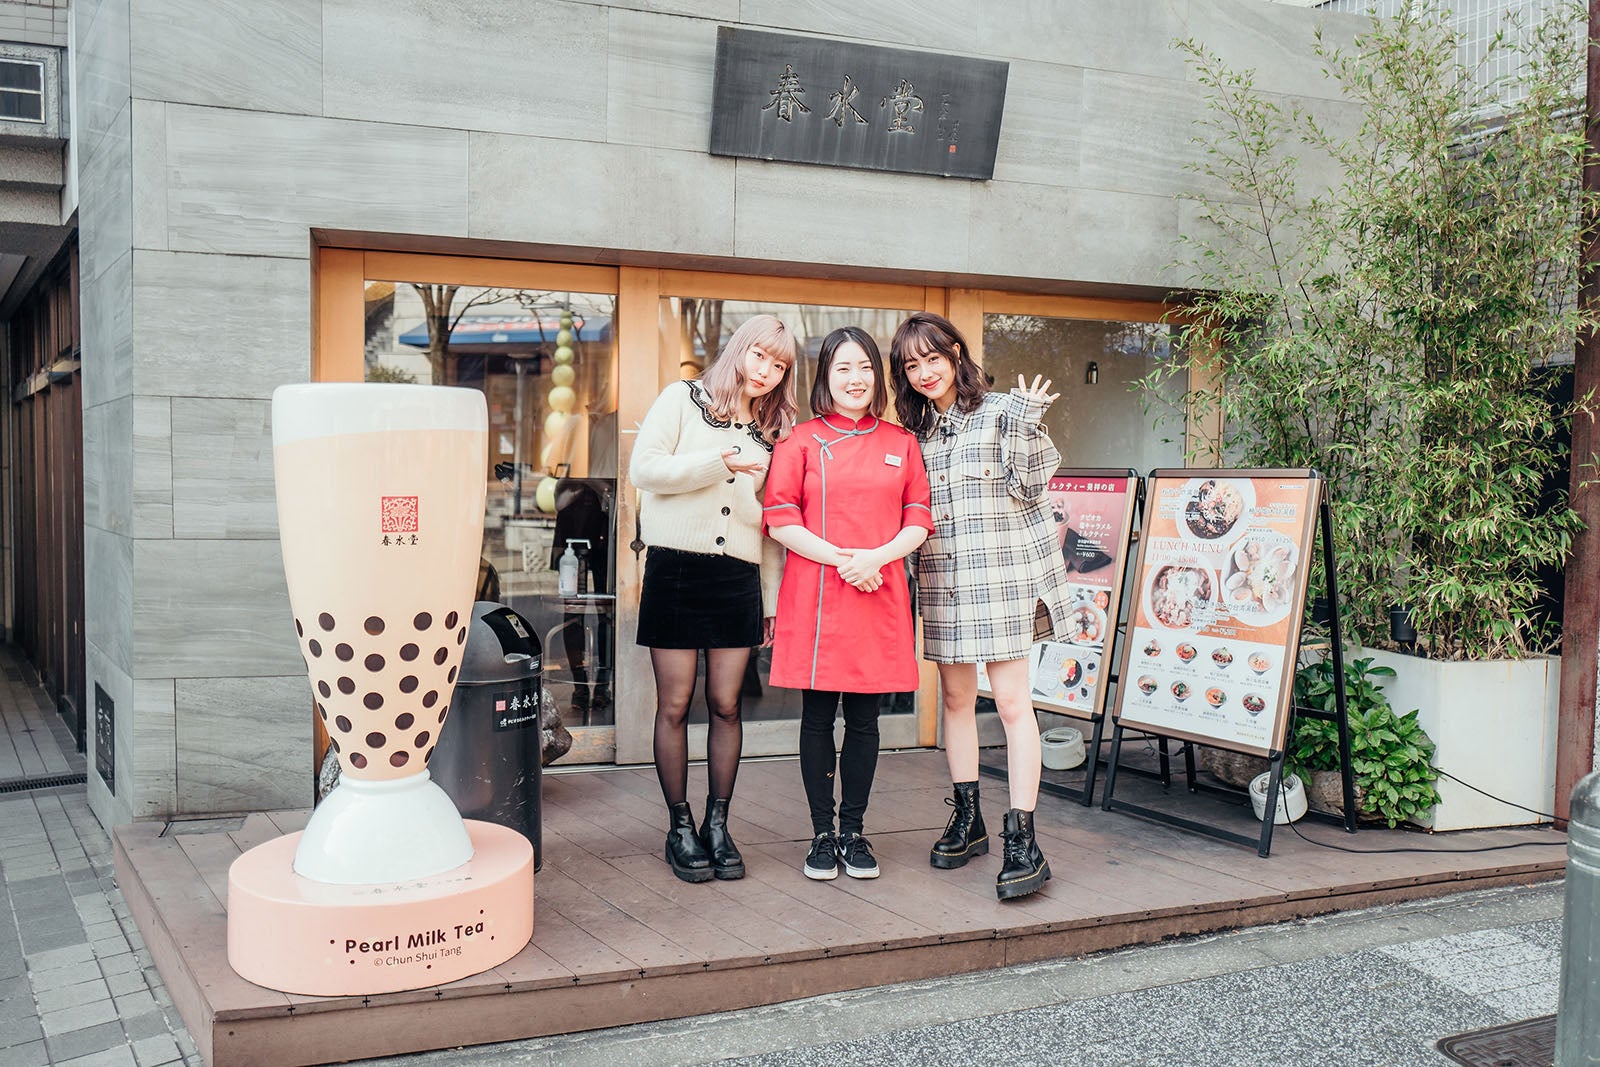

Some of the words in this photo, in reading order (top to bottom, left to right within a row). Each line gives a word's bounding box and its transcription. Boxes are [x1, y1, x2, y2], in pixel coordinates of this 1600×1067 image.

[761, 63, 926, 135] 春水堂
[1047, 482, 1115, 492] ルクティー発祥の店
[381, 533, 419, 547] 春水堂
[1153, 540, 1188, 551] LUNCH
[1192, 543, 1225, 554] MENU
[509, 691, 539, 711] 春水堂
[345, 935, 400, 954] Pearl
[407, 929, 447, 950] Milk
[454, 921, 484, 940] Tea
[386, 952, 413, 966] Chun
[415, 949, 438, 962] Shui
[440, 945, 462, 959] Tang
